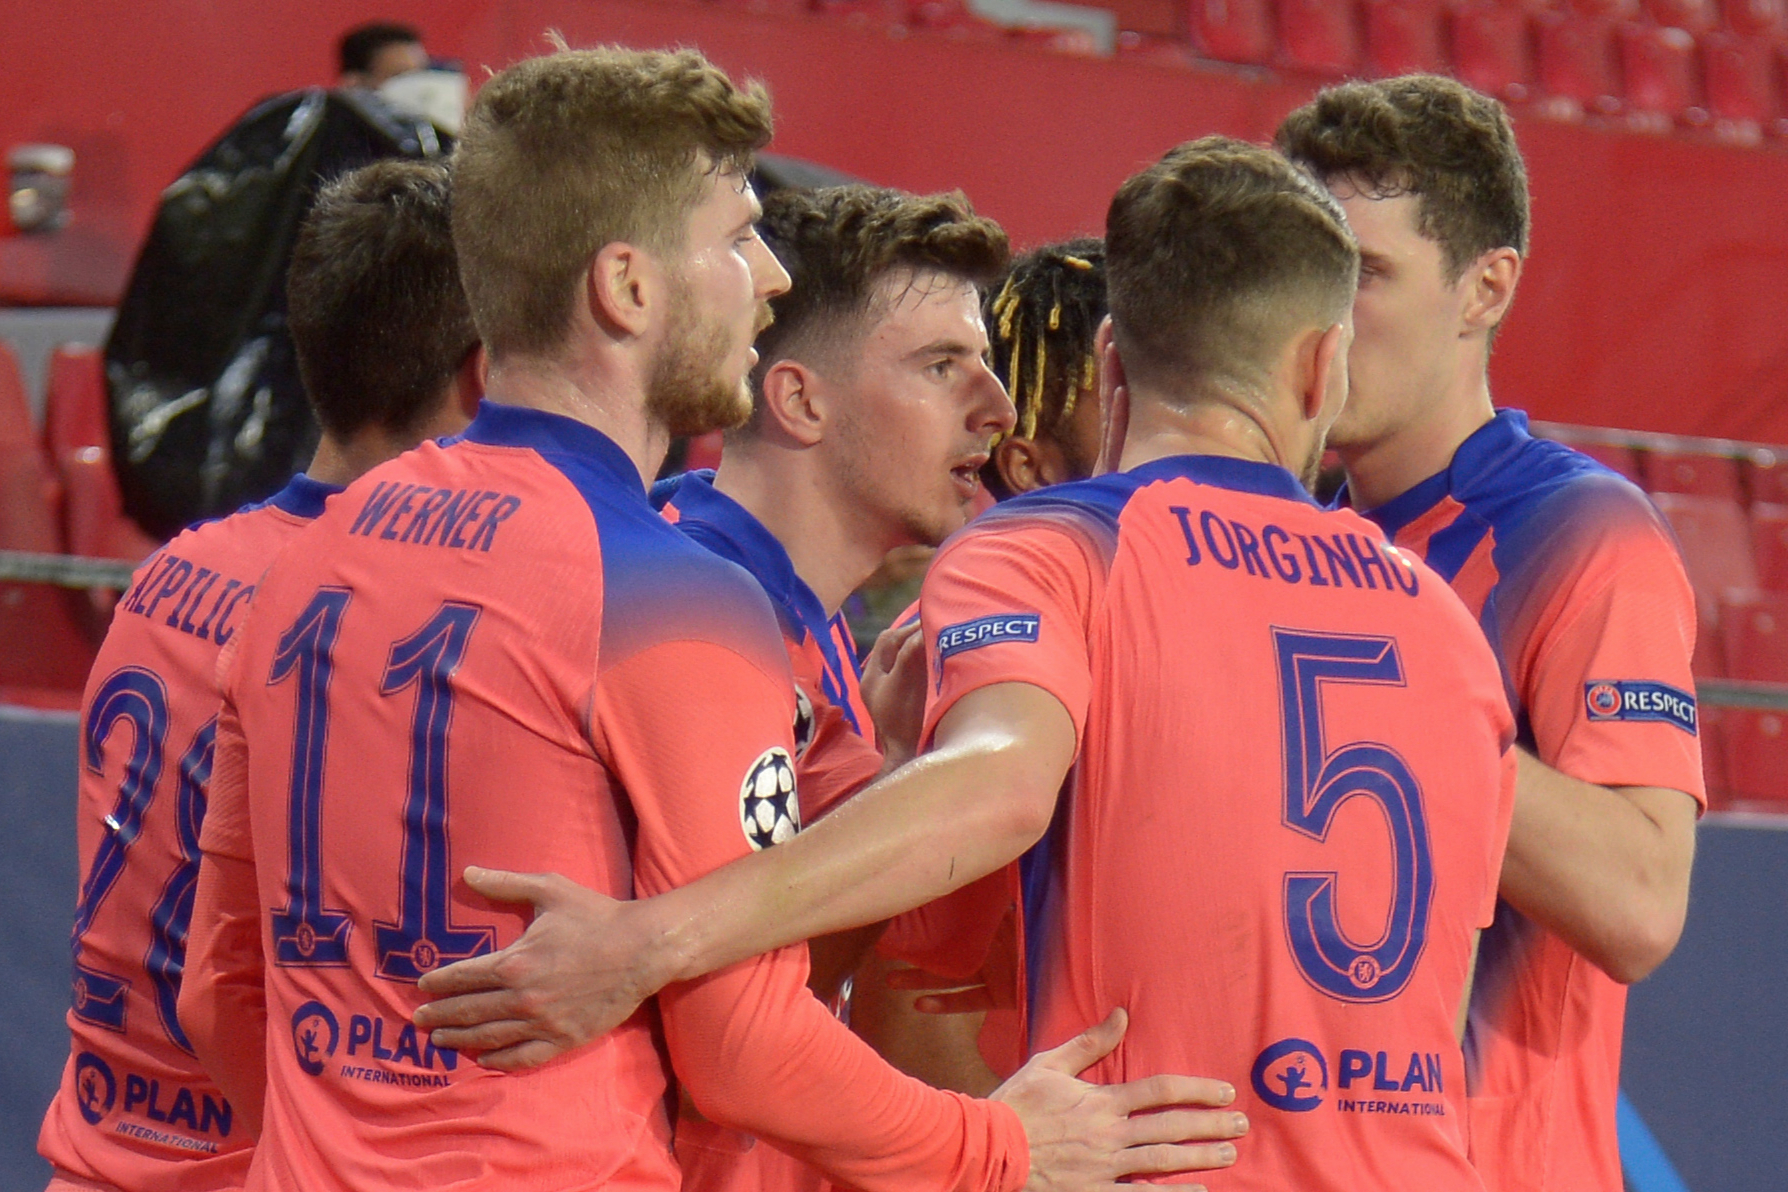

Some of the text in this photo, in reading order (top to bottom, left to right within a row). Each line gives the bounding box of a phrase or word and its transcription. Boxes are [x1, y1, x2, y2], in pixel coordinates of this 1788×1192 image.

[349, 481, 521, 552] WERNER
[939, 620, 1038, 654] RESPECT
[1624, 691, 1695, 724] RESPECT
[266, 584, 498, 983] 11
[1269, 624, 1437, 1004] 5
[347, 1014, 458, 1072] PLAN
[340, 1065, 452, 1087] INTERNATIONAL
[1338, 1049, 1443, 1093] PLAN
[124, 1073, 232, 1138] PLAN
[1338, 1100, 1445, 1116] INTERNATIONAL
[115, 1121, 218, 1154] INTERNATIONAL
